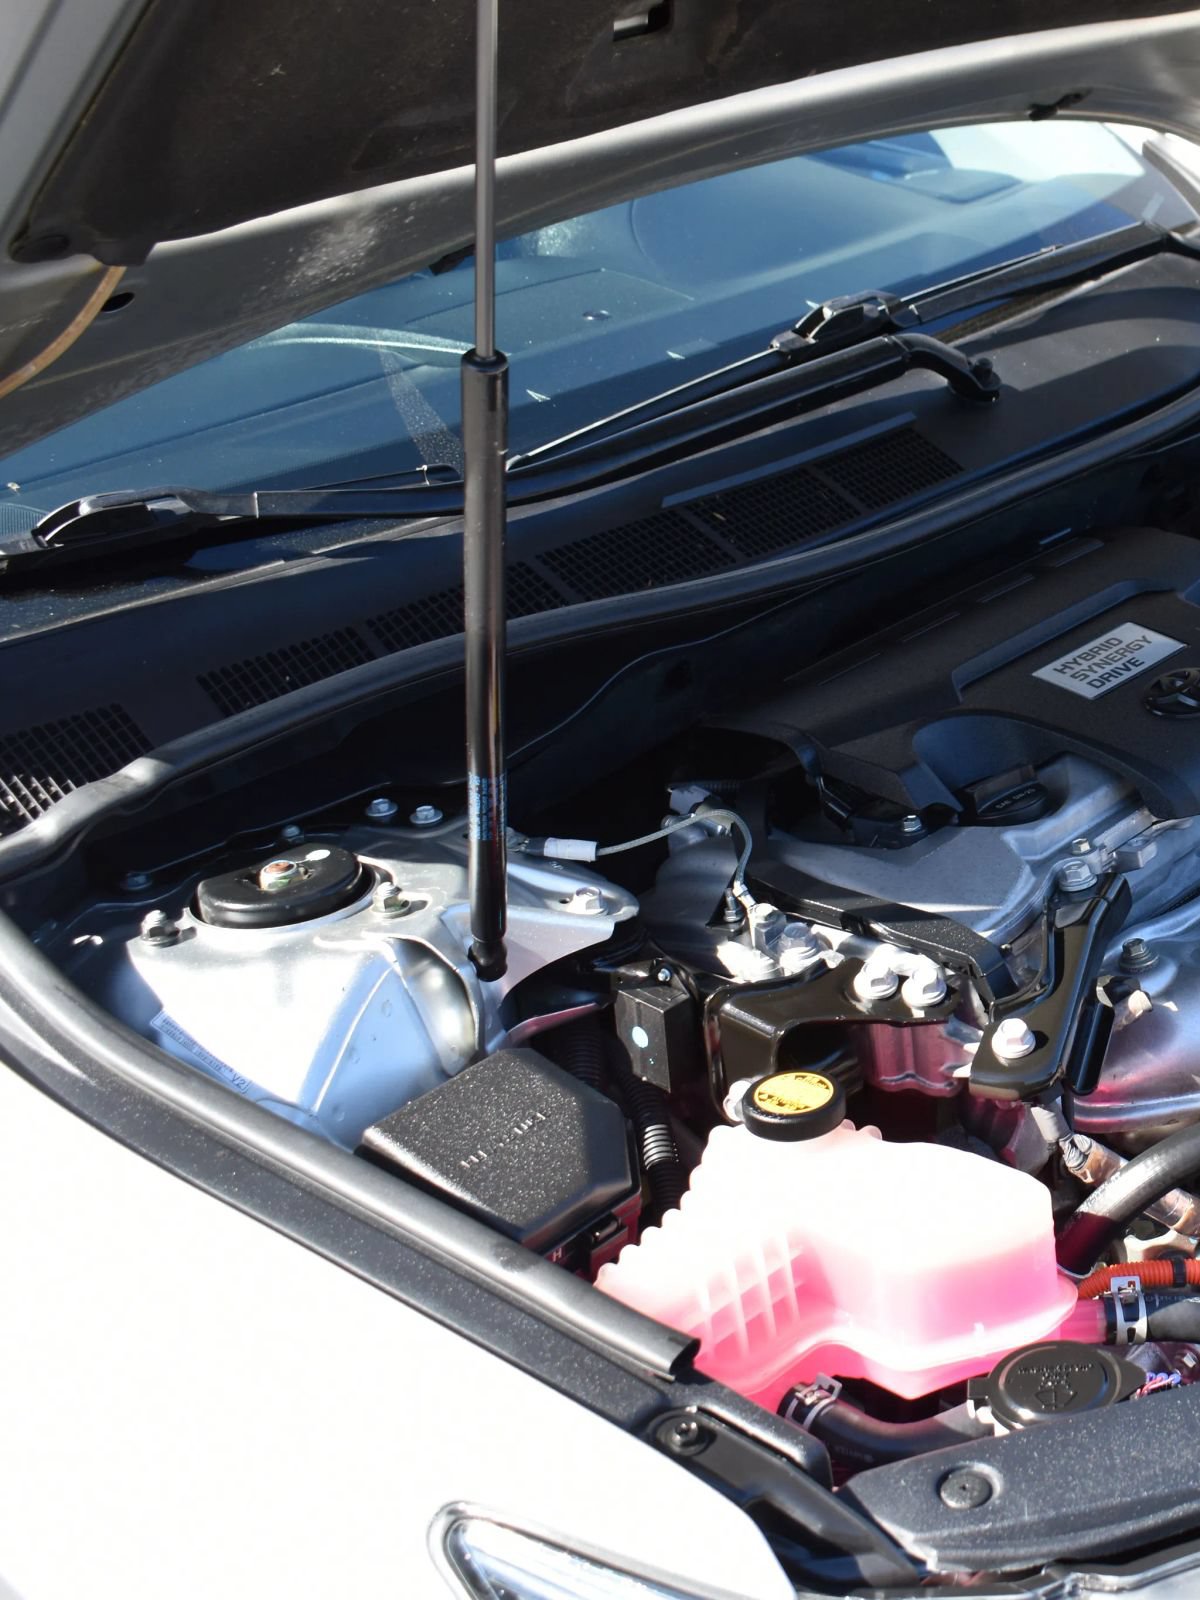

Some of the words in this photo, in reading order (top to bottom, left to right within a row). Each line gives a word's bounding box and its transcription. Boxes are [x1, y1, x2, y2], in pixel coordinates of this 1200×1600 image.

[1053, 637, 1123, 675] HYBRID
[1070, 635, 1152, 682] SYNERGY
[1086, 657, 1145, 689] DRIVE
